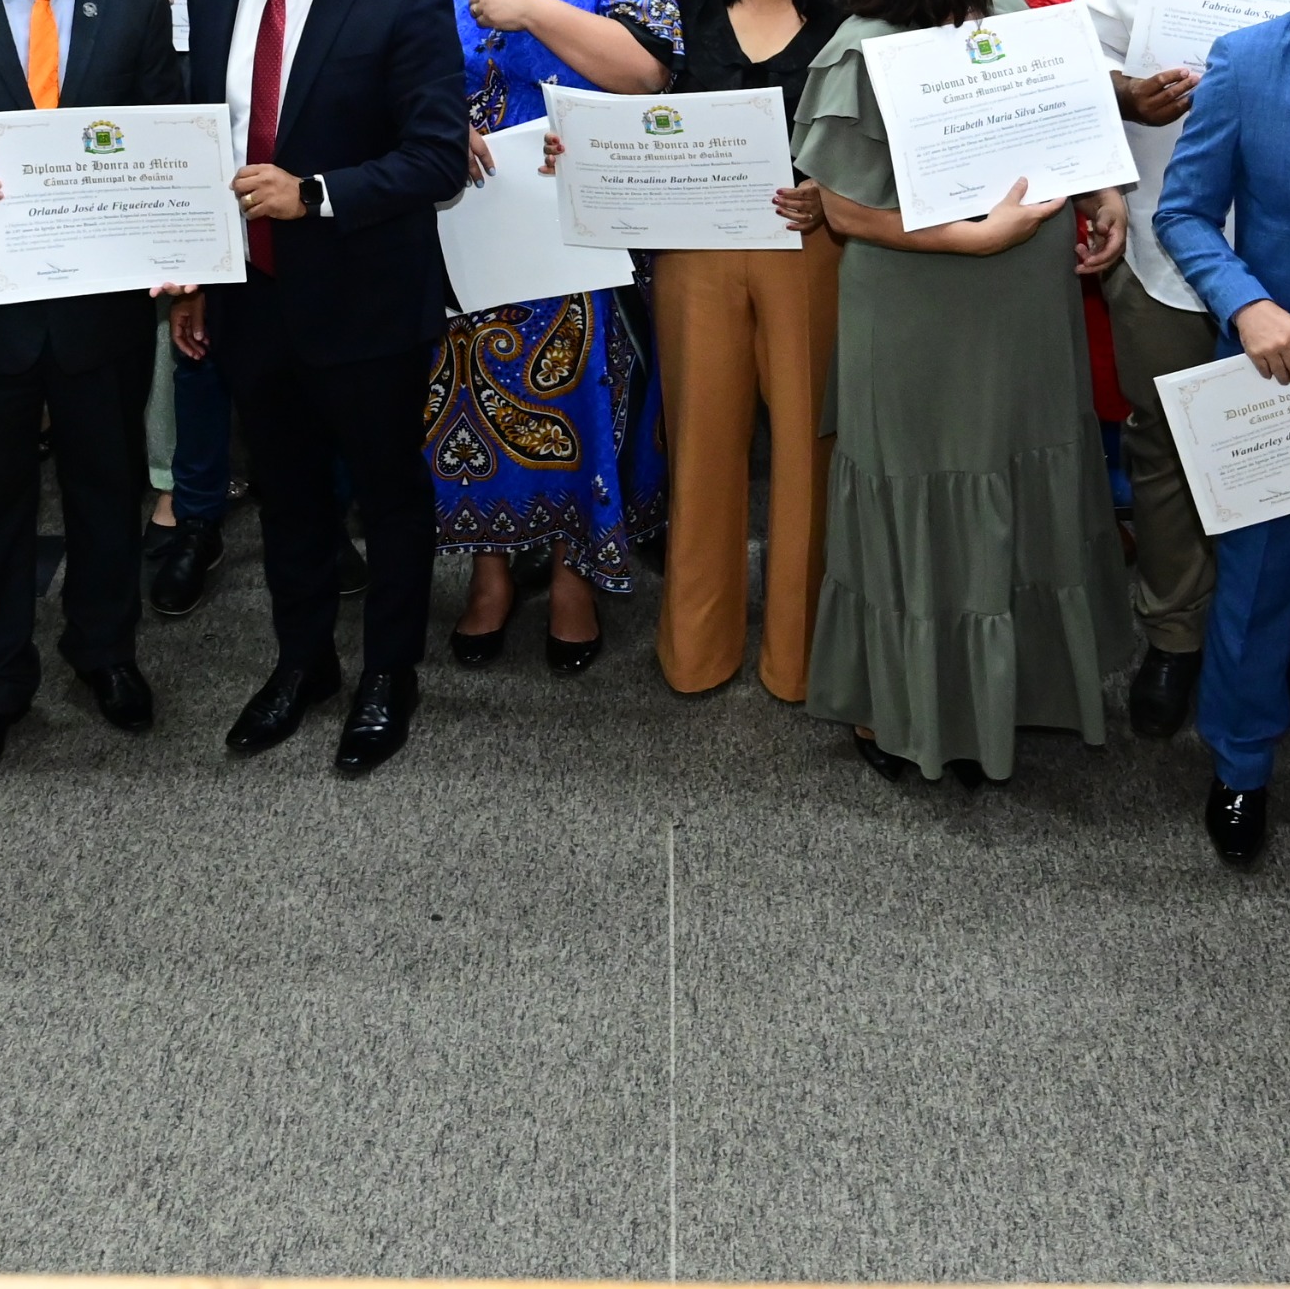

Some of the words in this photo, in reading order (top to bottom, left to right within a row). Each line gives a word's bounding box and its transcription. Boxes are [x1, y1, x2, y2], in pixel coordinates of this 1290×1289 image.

[1201, 0, 1241, 14] Fabricio
[1243, 7, 1259, 17] dos
[919, 78, 965, 94] Diploma
[966, 75, 978, 84] de
[979, 67, 1014, 81] Honra
[1016, 64, 1028, 74] ao
[1030, 56, 1064, 72] Mérito
[942, 91, 973, 104] Câmara
[975, 81, 1014, 98] Municipal
[1025, 73, 1055, 85] Goiânia
[943, 118, 983, 135] Elizabeth
[986, 111, 1012, 125] Maria
[1014, 107, 1035, 118] Silva
[1037, 100, 1066, 113] Santos
[588, 138, 635, 150] Diploma
[637, 141, 649, 150] de
[653, 140, 689, 150] Honra
[708, 136, 747, 148] Mérito
[609, 152, 641, 161] Câmara
[643, 152, 685, 161] Municipal
[699, 150, 732, 159] Goiânia
[21, 163, 72, 175] Diploma
[75, 161, 87, 171] de
[91, 160, 129, 172] Honra
[132, 161, 145, 169] ao
[148, 157, 188, 170] Mérito
[43, 176, 78, 187] Câmara
[81, 174, 125, 185] Municipal
[127, 174, 137, 182] de
[138, 172, 173, 182] Goiânia
[600, 175, 624, 183] Neila
[669, 175, 708, 183] Barbosa
[711, 173, 748, 182] Macedo
[28, 205, 69, 216] Orlando
[71, 202, 94, 213] José
[96, 202, 108, 211] de
[111, 199, 164, 212] Figueiredo
[167, 199, 190, 207] Neto
[1223, 398, 1275, 421] Diploma
[1277, 393, 1290, 403] de
[1248, 409, 1284, 425] Câmara
[1231, 436, 1283, 458] Wanderley
